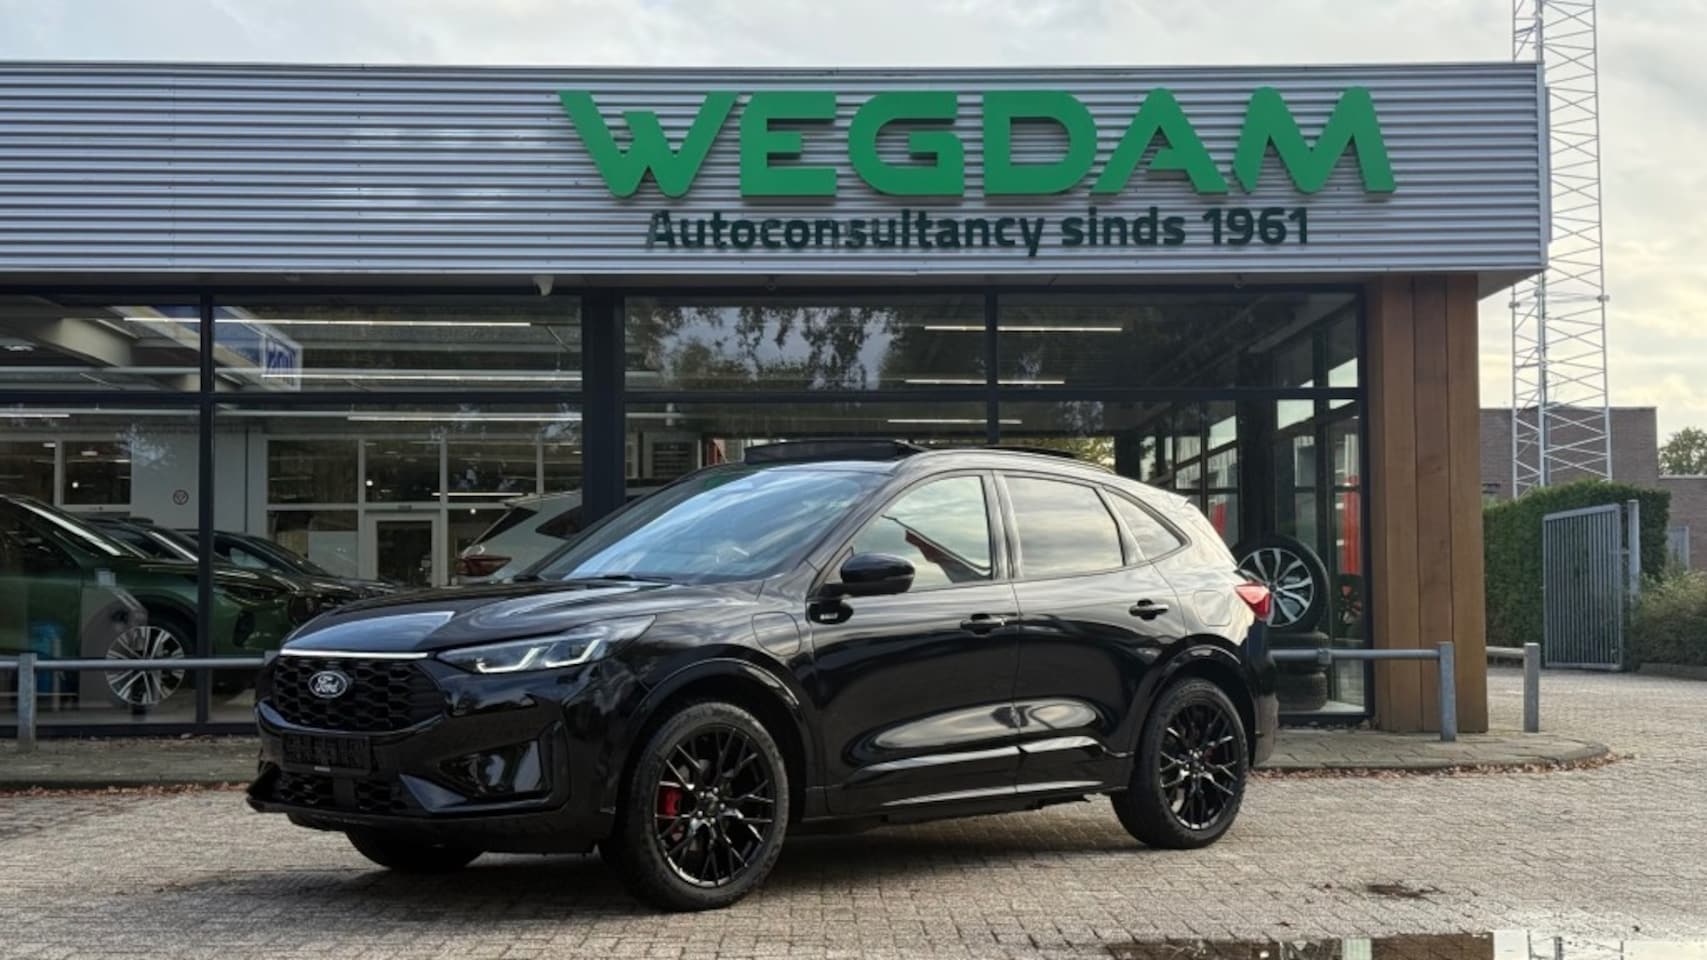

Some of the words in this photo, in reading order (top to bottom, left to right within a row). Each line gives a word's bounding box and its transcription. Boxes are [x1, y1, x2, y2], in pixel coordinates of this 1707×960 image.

[557, 86, 1396, 198] WEGDAM
[647, 208, 1044, 257] Autoconsultancy
[1061, 207, 1186, 246] sinds
[1203, 207, 1308, 246] 1961
